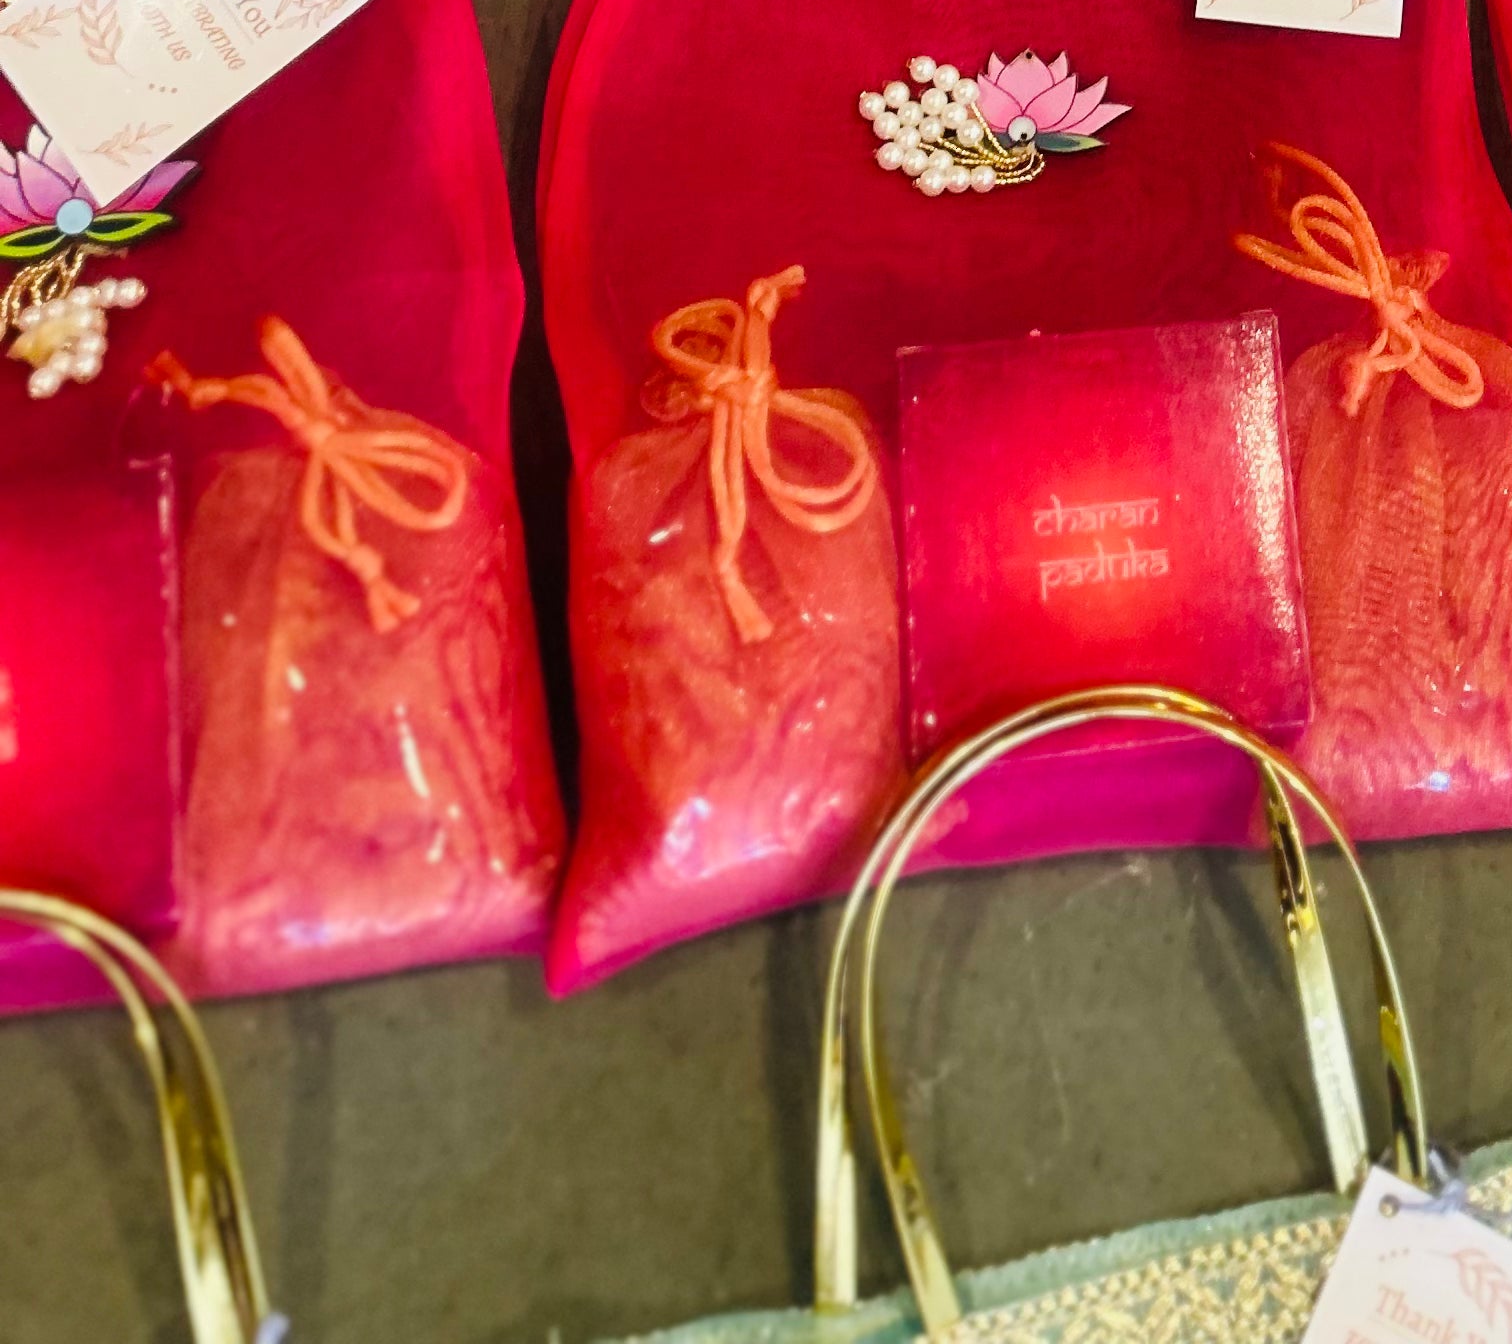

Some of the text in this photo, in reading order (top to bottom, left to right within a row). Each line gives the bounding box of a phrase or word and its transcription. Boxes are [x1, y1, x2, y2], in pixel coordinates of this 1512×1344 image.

[167, 40, 192, 62] US
[1032, 493, 1159, 536] charan
[1039, 537, 1169, 603] paduka
[1376, 1283, 1458, 1344] Thank
